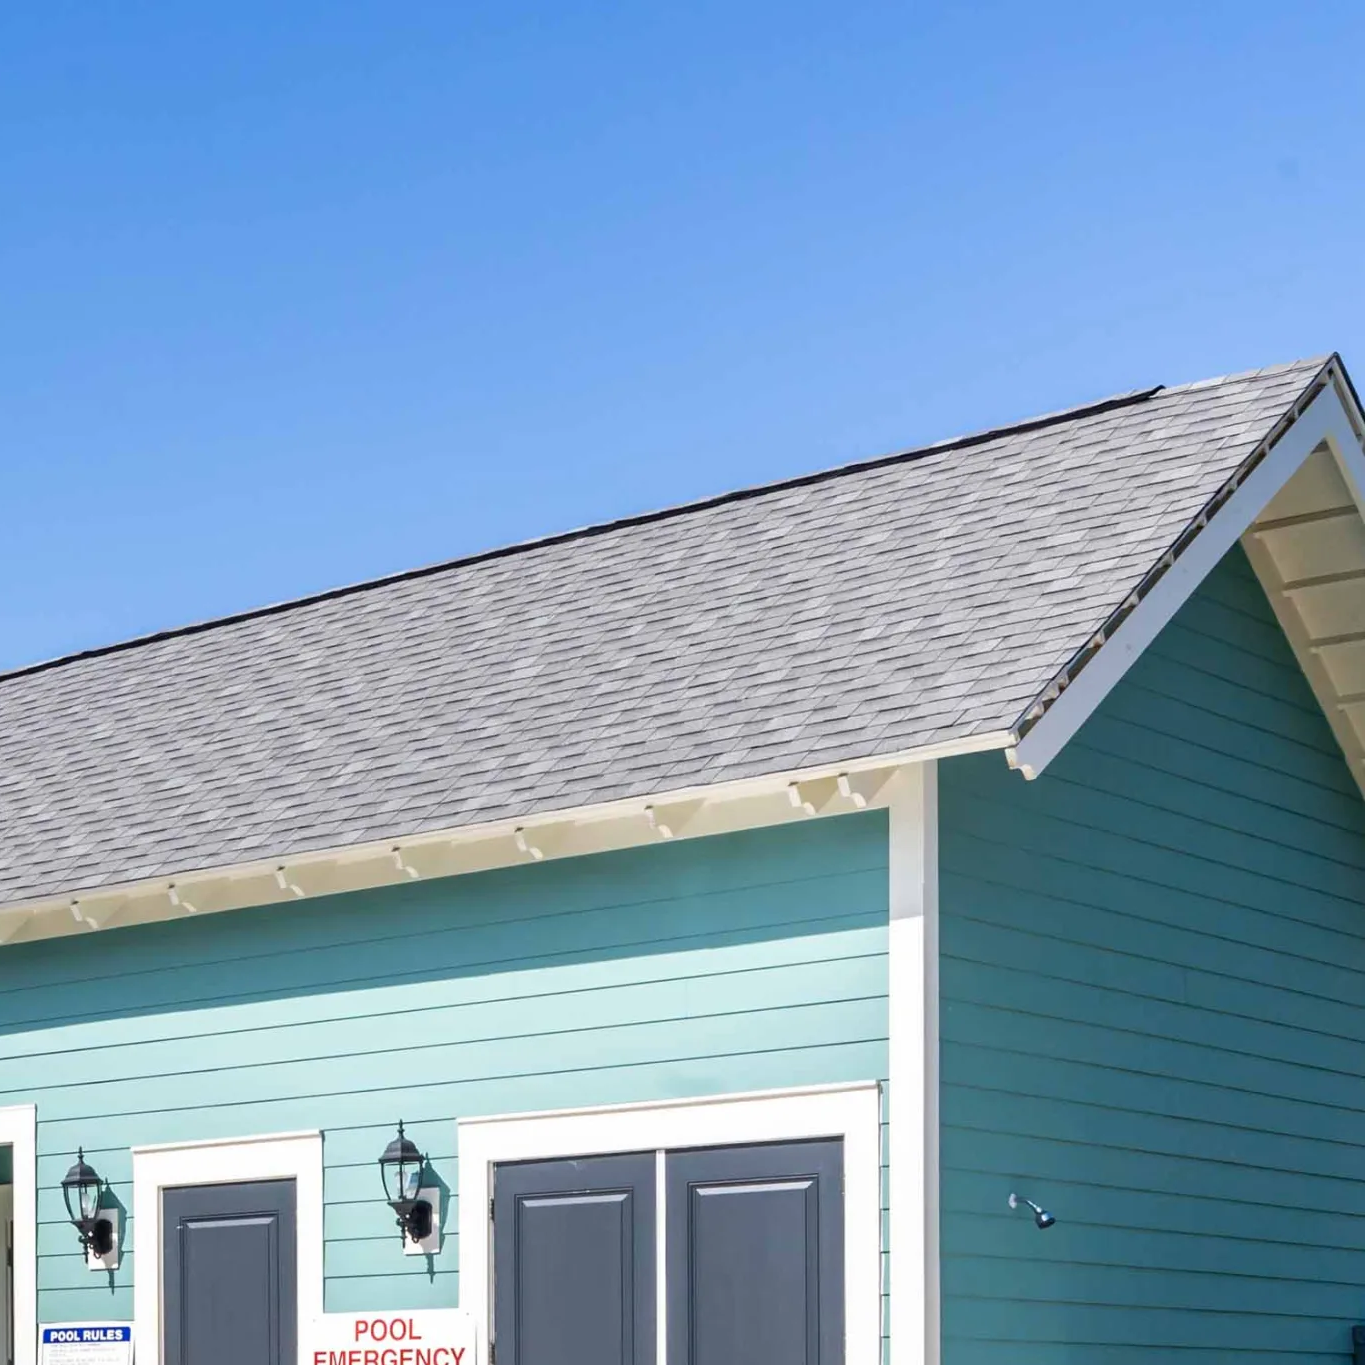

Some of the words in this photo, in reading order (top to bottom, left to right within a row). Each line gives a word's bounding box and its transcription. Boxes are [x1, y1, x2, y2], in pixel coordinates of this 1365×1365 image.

[50, 1331, 80, 1342] POOL
[83, 1329, 123, 1341] RULES
[355, 1318, 422, 1342] POOL
